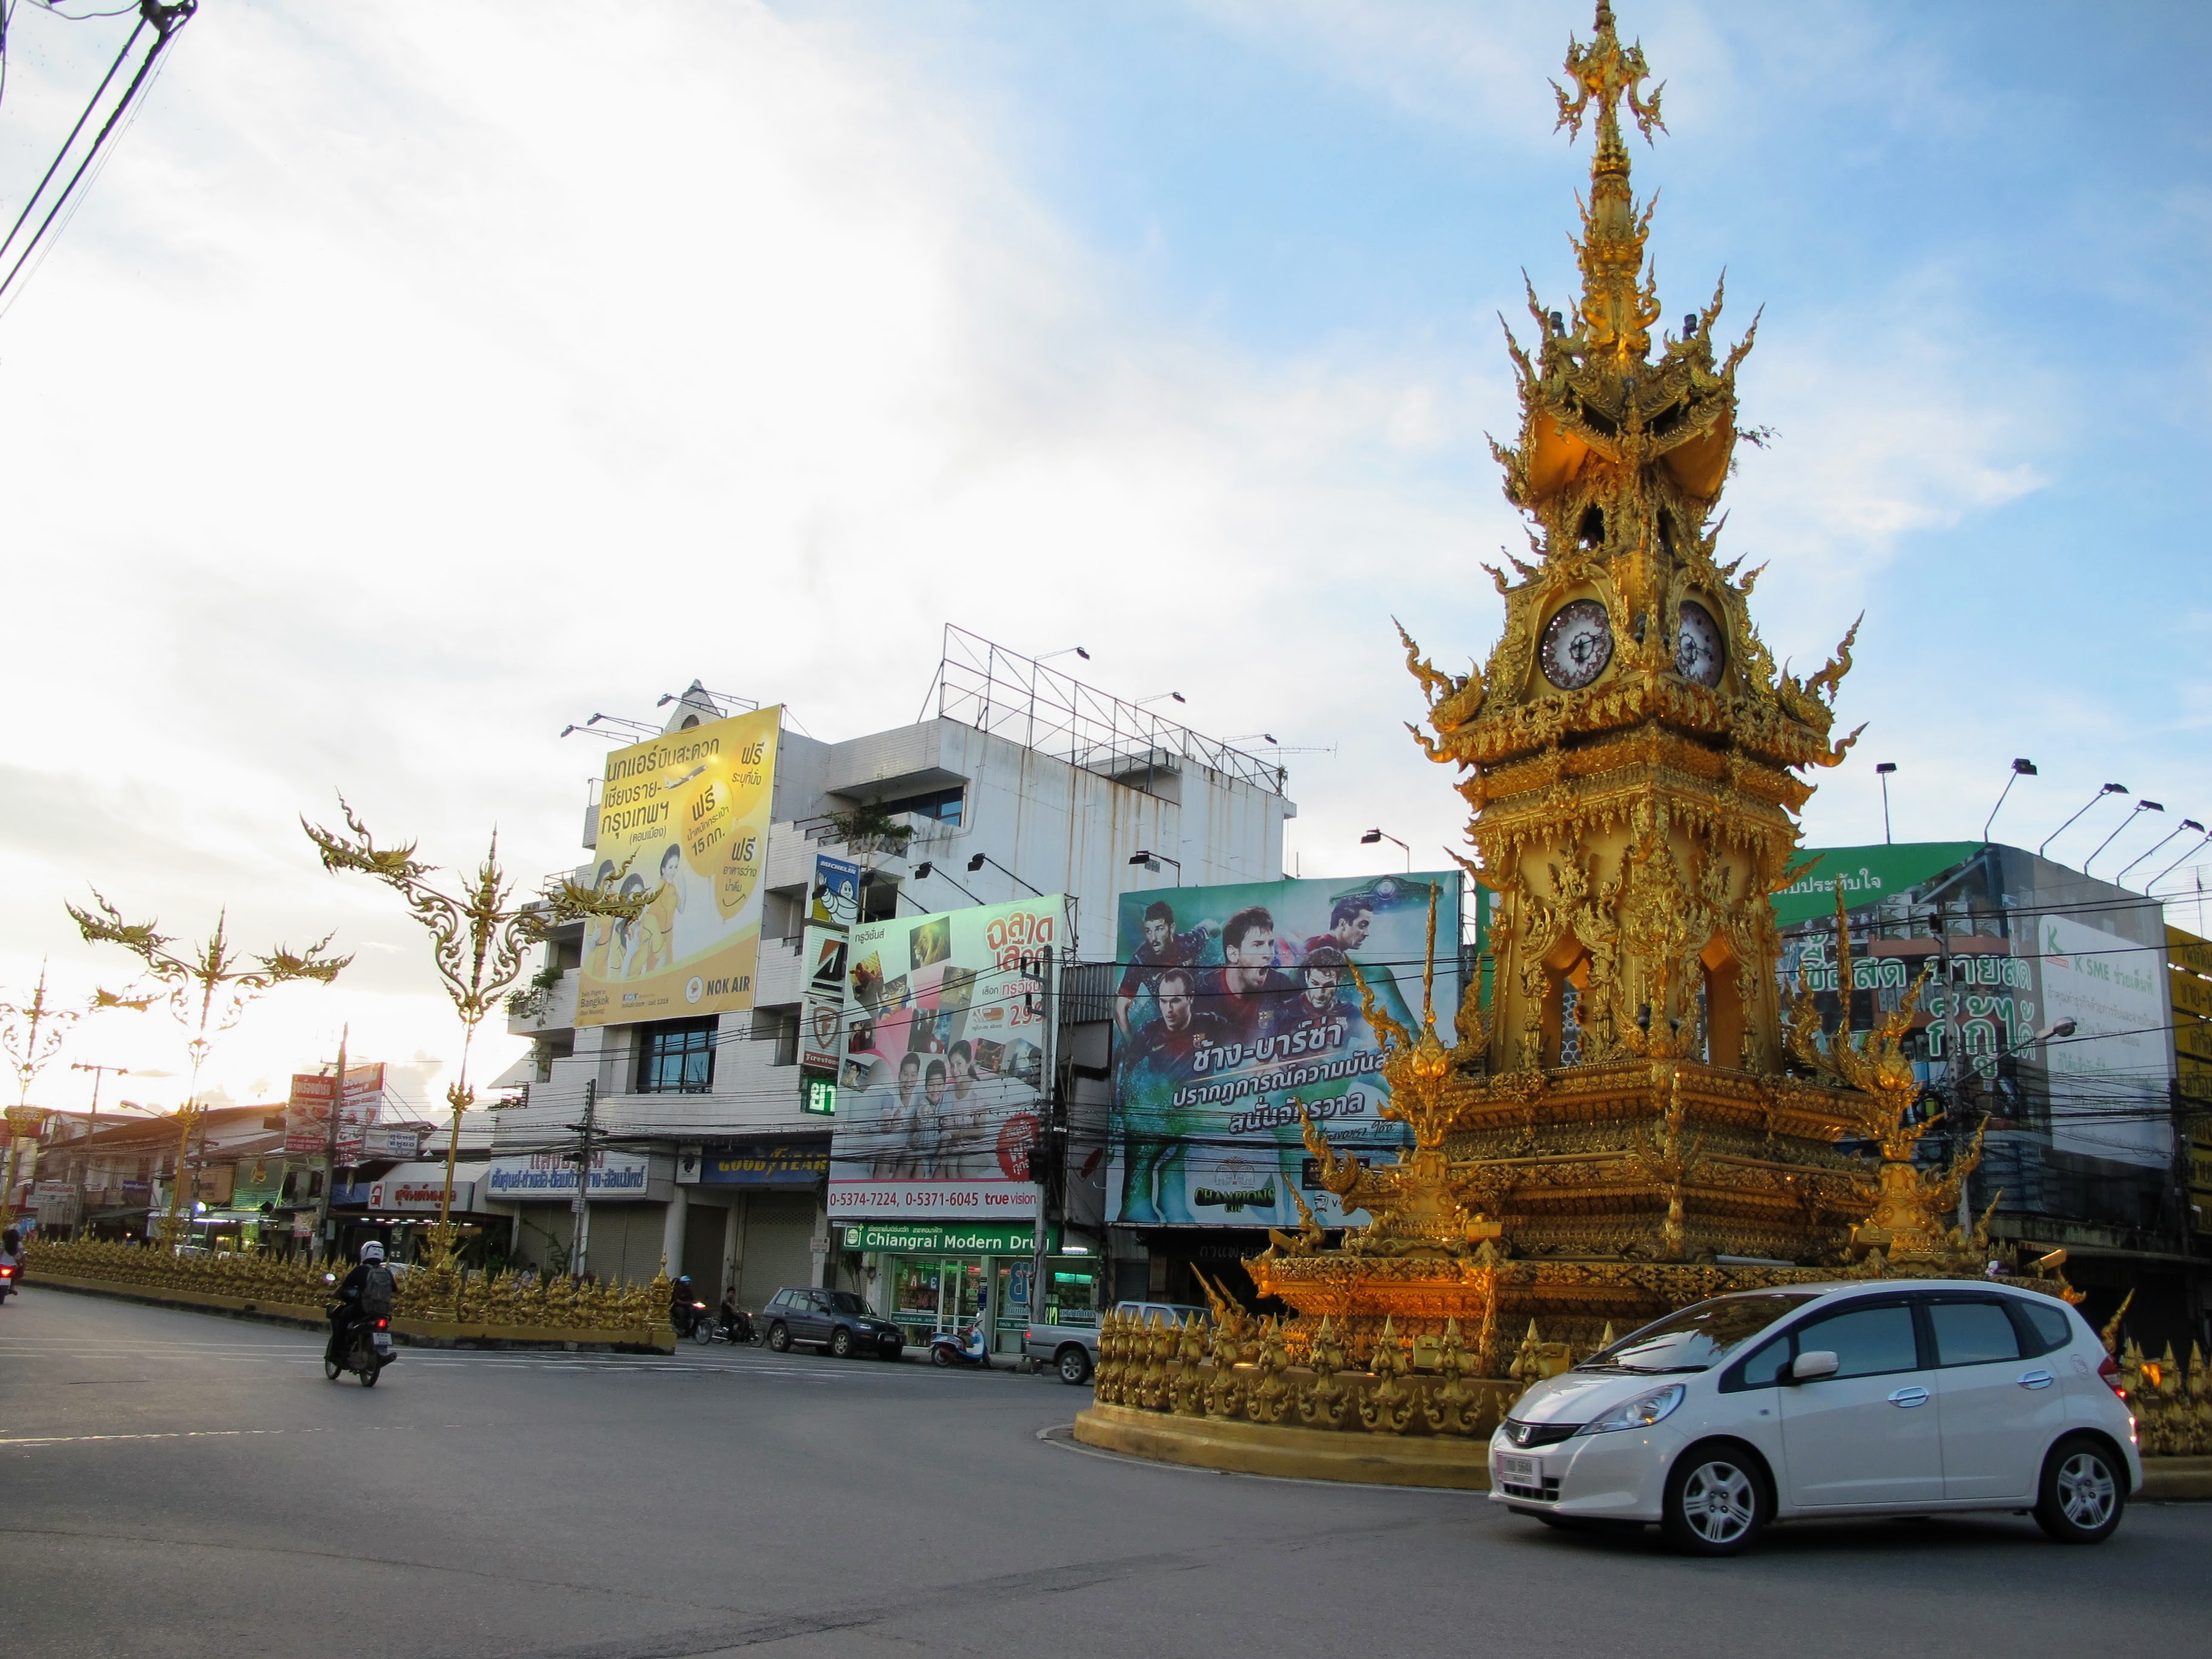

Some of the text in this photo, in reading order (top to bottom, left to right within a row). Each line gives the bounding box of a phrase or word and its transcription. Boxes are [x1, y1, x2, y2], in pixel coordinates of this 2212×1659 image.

[741, 742, 765, 765] ฟรี
[692, 785, 716, 821] ฟรี
[602, 801, 669, 839] กรุงเทพฯ
[732, 837, 756, 861] ฟรี
[820, 860, 857, 874] MICHELIN
[855, 927, 885, 944] ทรูวิชั่นส์
[987, 912, 1054, 950] ฉลาด
[2074, 954, 2083, 973] K
[2086, 958, 2110, 982] SME
[706, 976, 751, 996] NOK AIR
[982, 986, 999, 996] เลือก
[581, 995, 609, 1008] Bangkok
[1192, 1016, 1343, 1073] ช้าง-บาร์ซ่า
[809, 1082, 837, 1112] ยา
[830, 1193, 900, 1207] 0-5374-7224,
[906, 1192, 978, 1206] 0-5371-6045
[1195, 1187, 1276, 1207] CHAMPIONS
[1224, 1204, 1244, 1213] CUP
[866, 1234, 1050, 1252] Chiangrai Modern Dru
[902, 1269, 938, 1289] SALE
